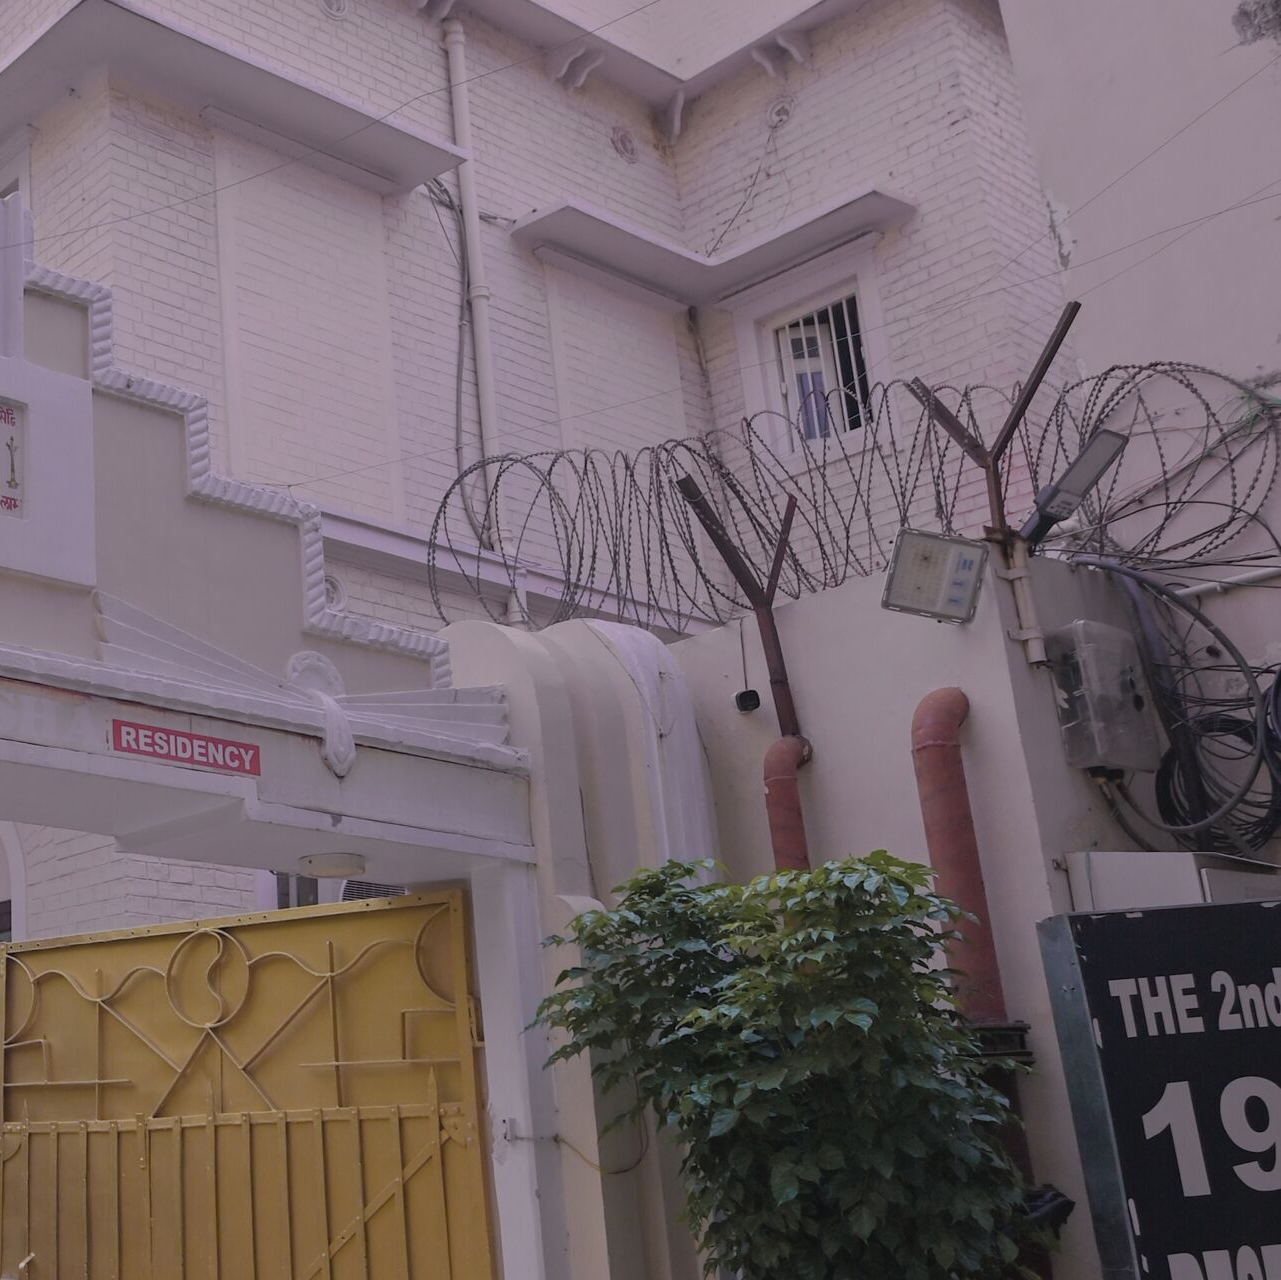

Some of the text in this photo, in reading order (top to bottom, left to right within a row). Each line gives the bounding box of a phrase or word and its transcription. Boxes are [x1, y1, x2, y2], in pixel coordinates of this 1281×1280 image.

[120, 725, 254, 770] RESIDENCY
[1108, 967, 1281, 1038] THE 2nd
